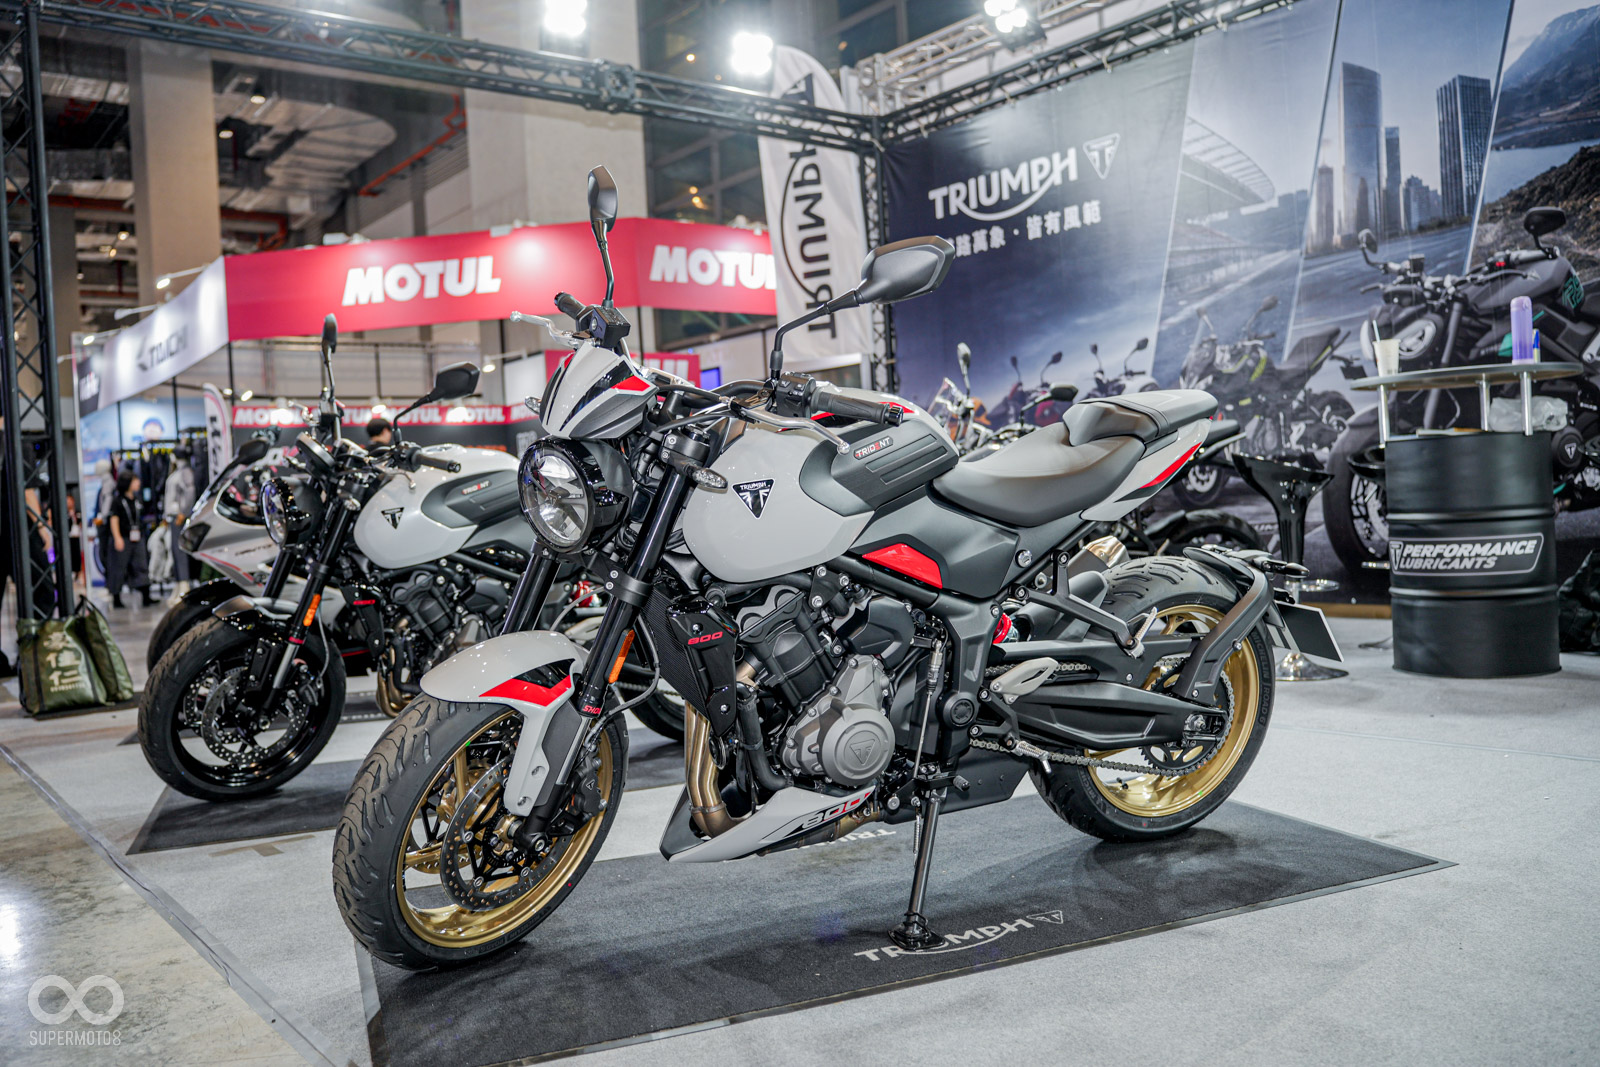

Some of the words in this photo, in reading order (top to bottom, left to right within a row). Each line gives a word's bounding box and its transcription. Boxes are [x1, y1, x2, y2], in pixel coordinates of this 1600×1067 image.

[928, 147, 1078, 221] TRIUMPH
[342, 255, 501, 306] MOTUL
[855, 437, 891, 457] TRIDENT
[739, 482, 767, 490] TRIUMPH
[1400, 556, 1498, 570] LUBRICANTS
[1402, 540, 1537, 558] PERFORMANCE
[688, 631, 723, 645] 800
[1250, 630, 1270, 679] MICHELIN
[1259, 687, 1271, 715] ROAD
[800, 791, 869, 831] 800
[853, 917, 1036, 962] TRMPH
